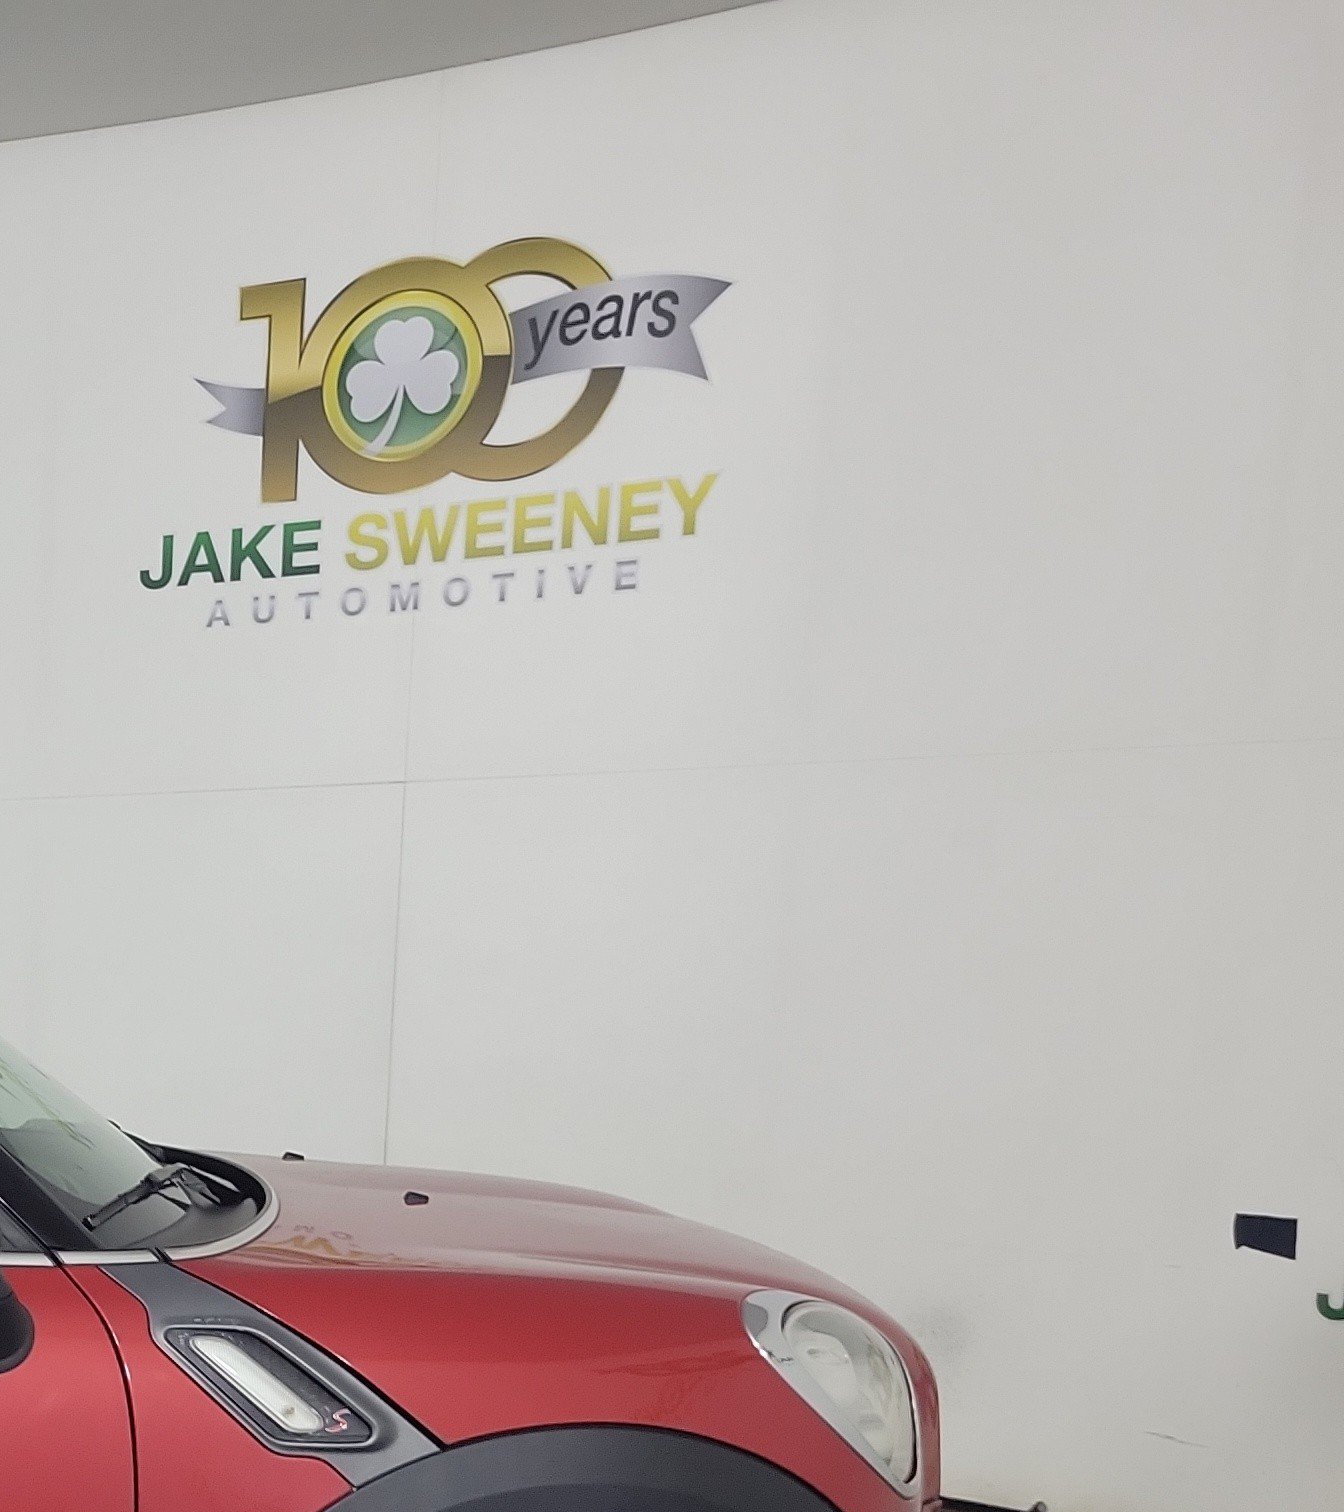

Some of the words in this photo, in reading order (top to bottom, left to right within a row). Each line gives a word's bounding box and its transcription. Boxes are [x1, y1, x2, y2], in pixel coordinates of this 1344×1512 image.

[524, 289, 679, 371] years
[140, 520, 322, 590] JAKE
[345, 473, 717, 572] SWEENEY
[205, 560, 639, 628] AUTOMOTIVE
